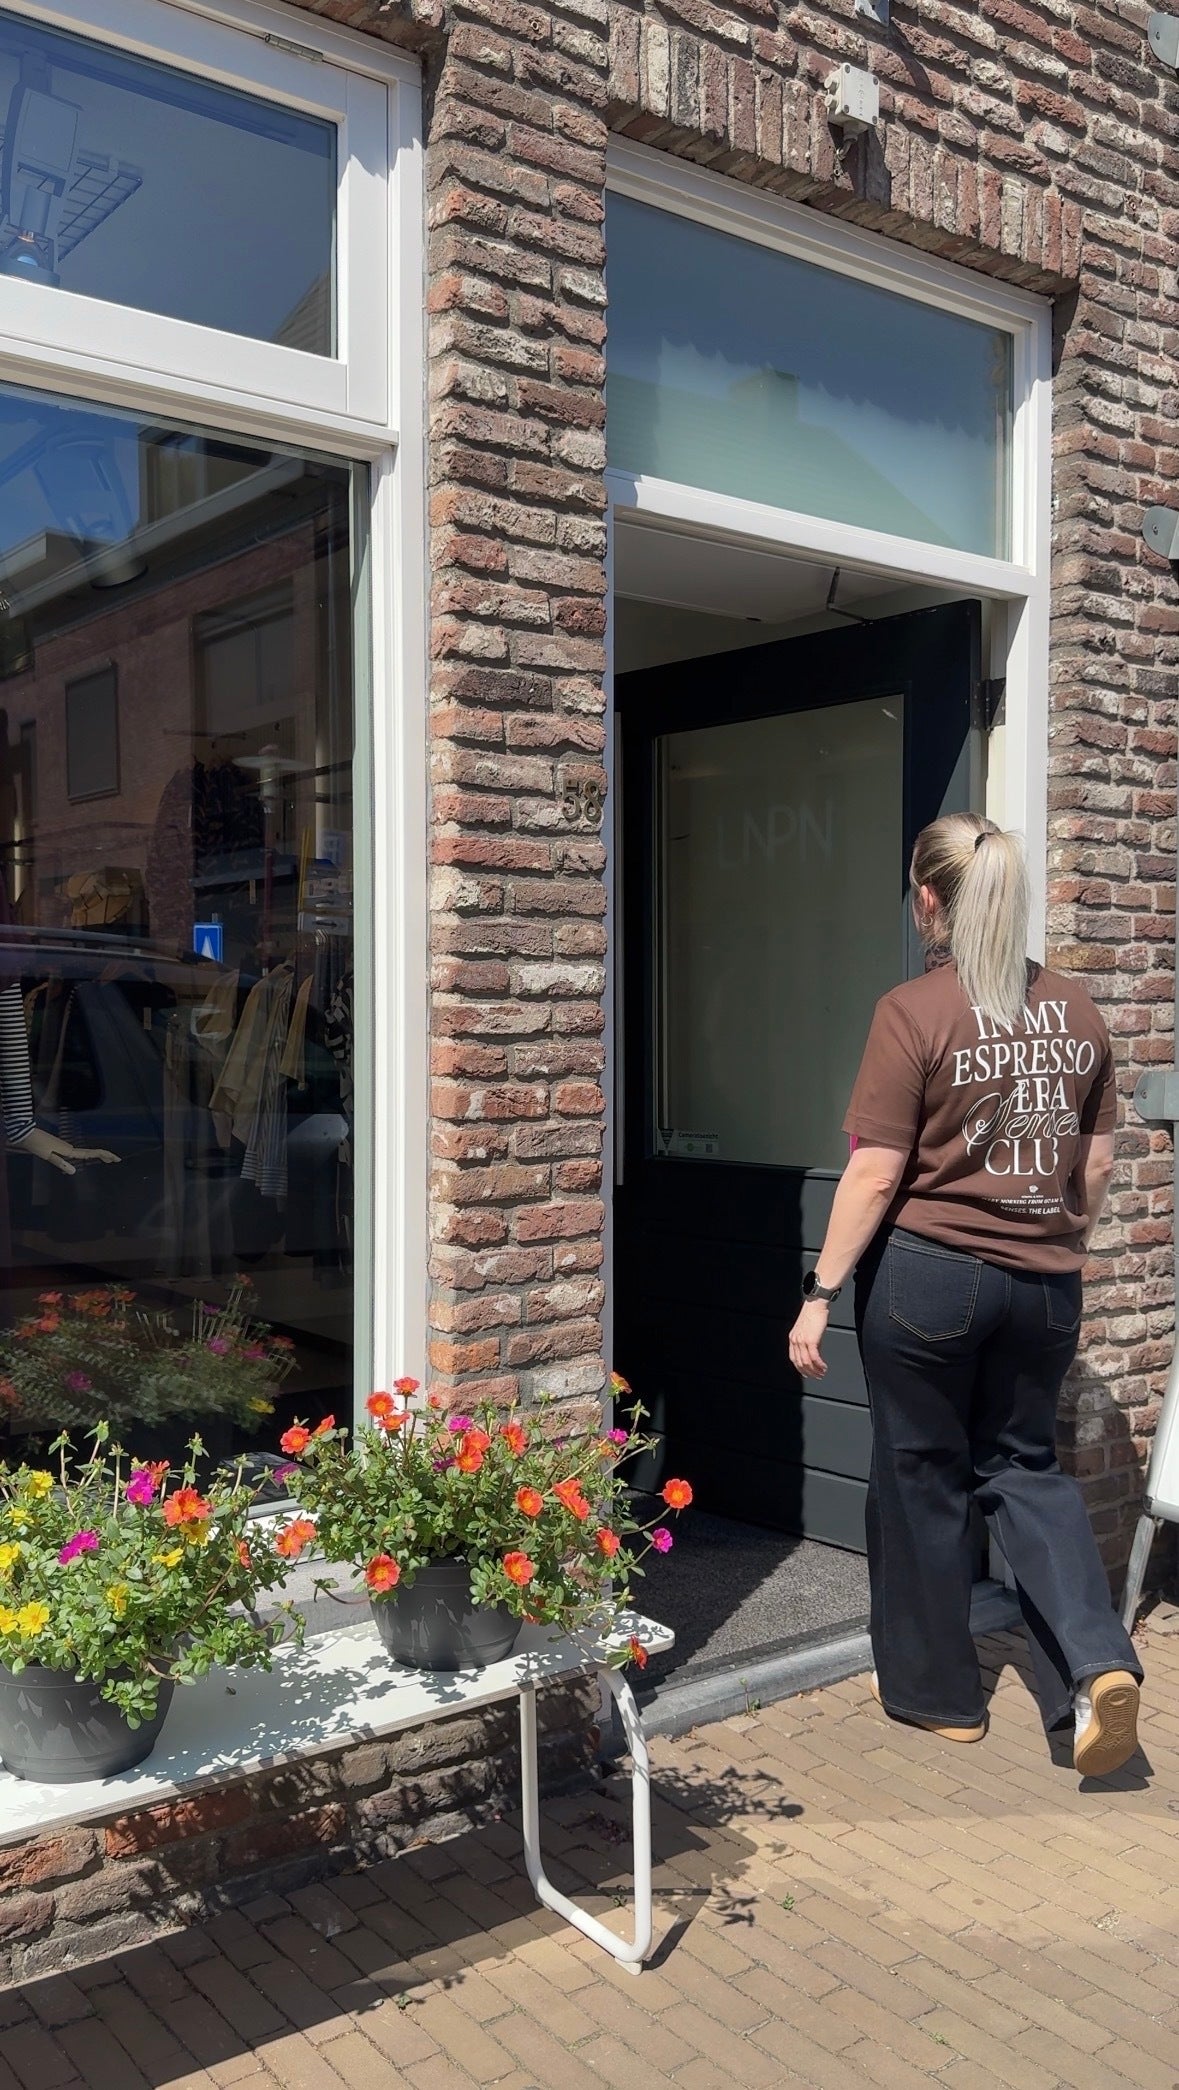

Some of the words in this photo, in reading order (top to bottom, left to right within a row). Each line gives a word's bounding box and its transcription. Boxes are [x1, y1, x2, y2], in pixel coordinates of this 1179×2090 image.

[562, 779, 602, 821] 58
[1023, 1000, 1069, 1035] MY
[951, 1039, 1095, 1087] ESPRESSO
[1013, 1076, 1070, 1113] ERA
[1028, 1207, 1042, 1215] THE
[1042, 1206, 1061, 1215] LABEL
